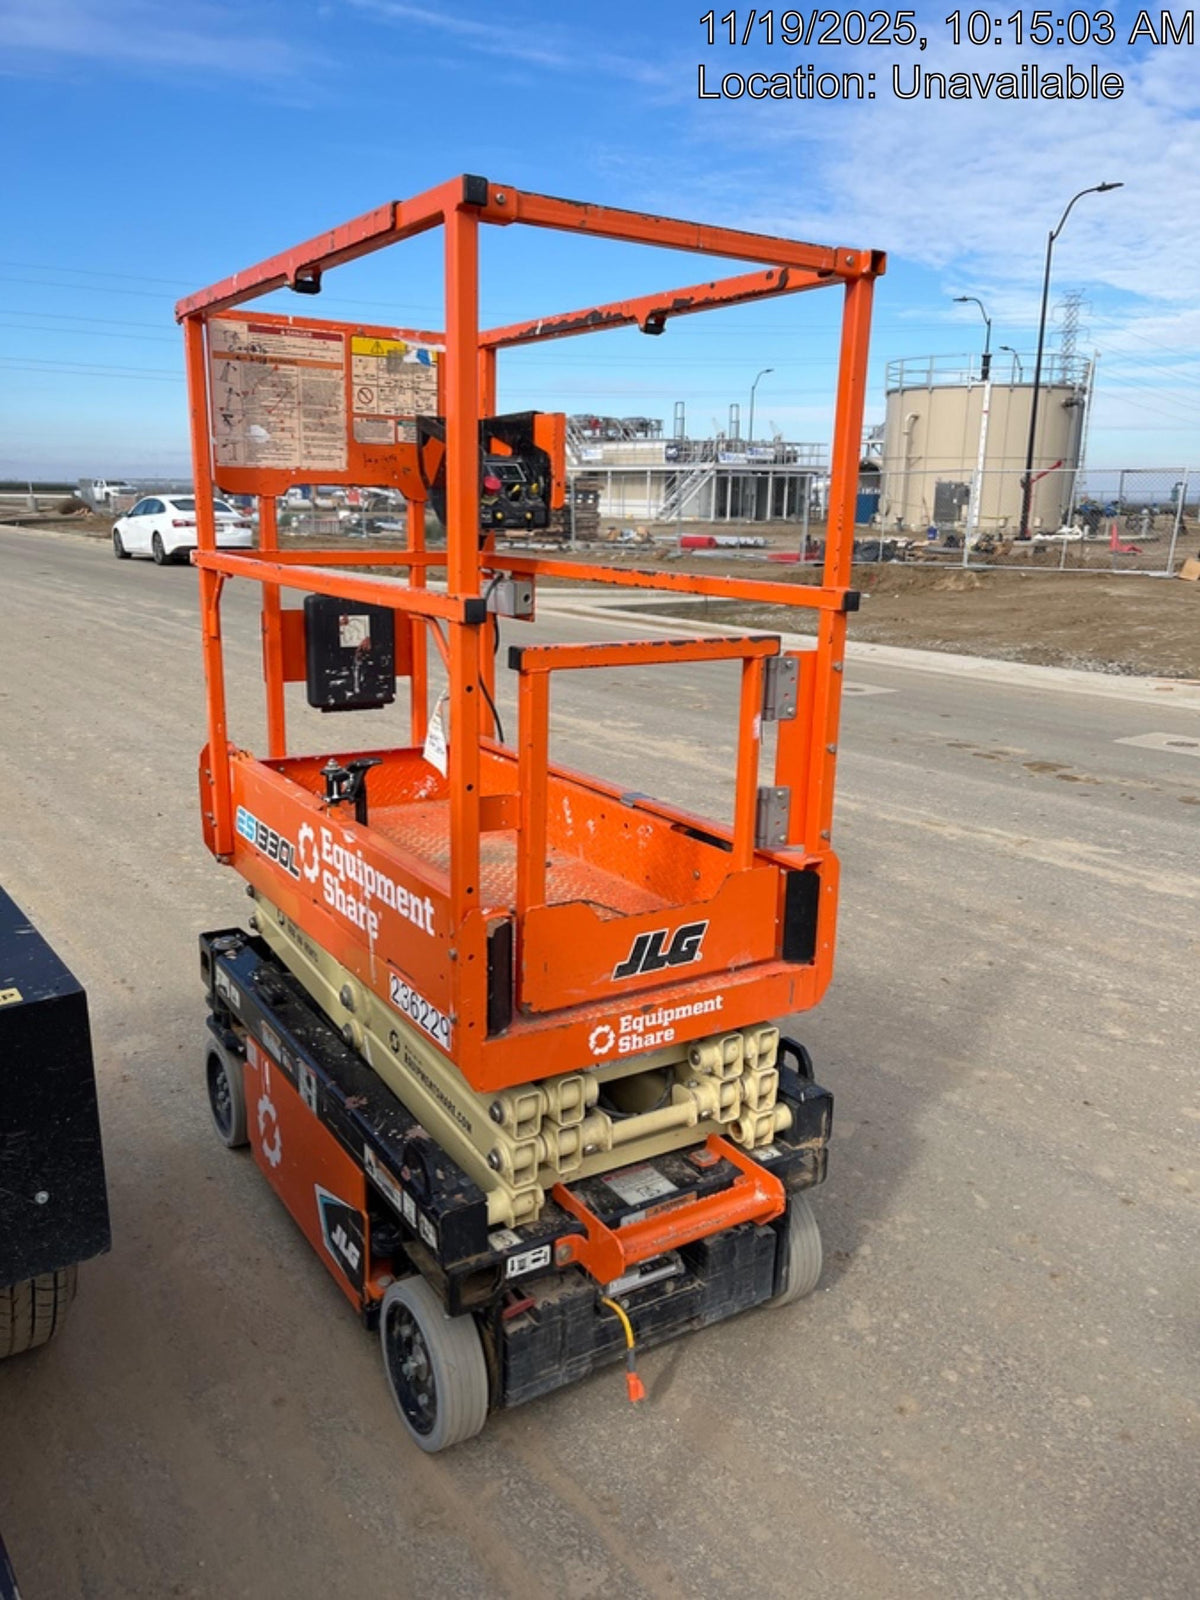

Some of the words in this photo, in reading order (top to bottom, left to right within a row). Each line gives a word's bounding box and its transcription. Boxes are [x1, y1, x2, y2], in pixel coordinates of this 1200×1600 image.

[236, 806, 301, 879] ES1330L
[320, 826, 436, 937] Equipment
[322, 869, 379, 940] Share
[612, 919, 709, 981] JLG
[391, 975, 450, 1048] 236229
[618, 1028, 675, 1054] Share
[619, 995, 724, 1034] Equipment
[331, 1224, 360, 1271] JLG
